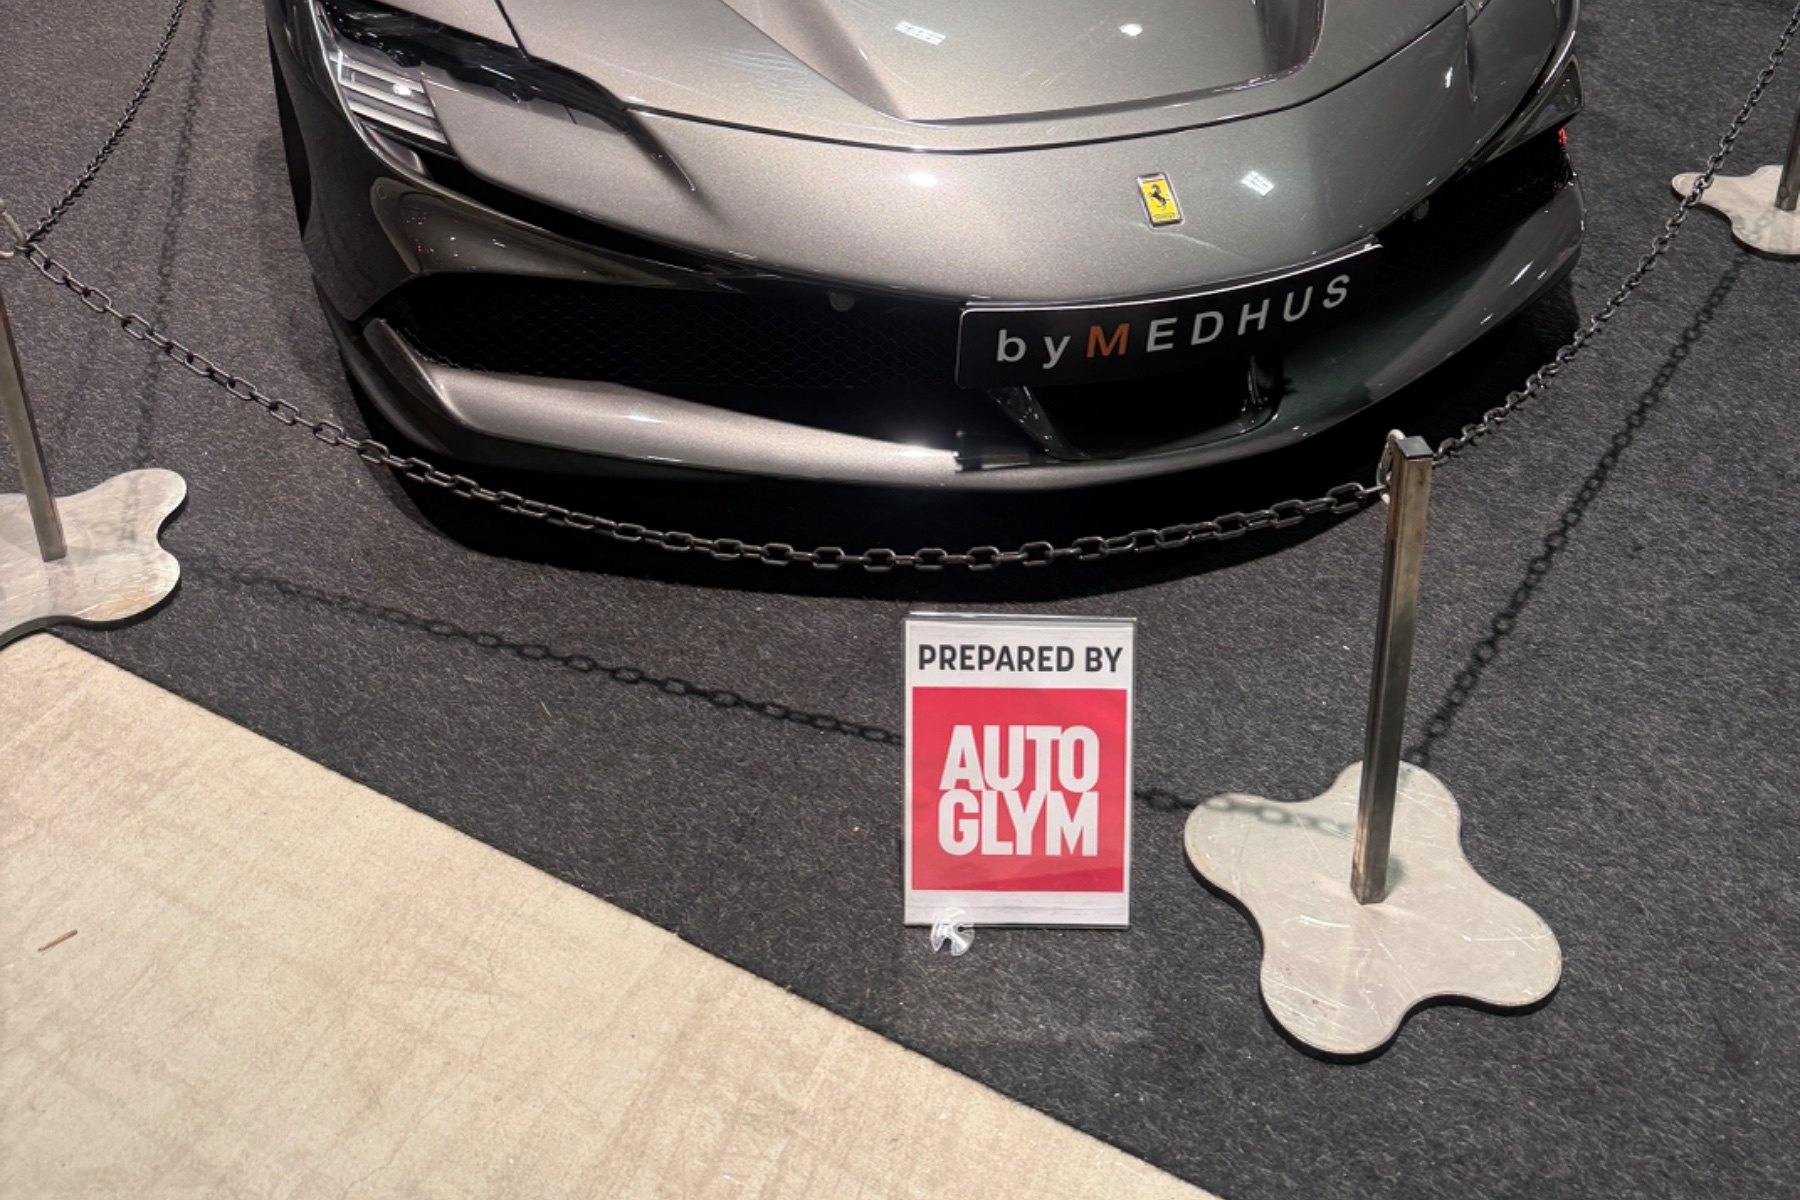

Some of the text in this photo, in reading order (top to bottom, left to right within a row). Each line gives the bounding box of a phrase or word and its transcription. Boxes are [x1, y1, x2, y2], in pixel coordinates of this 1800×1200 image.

[918, 644, 1123, 672] PREPARED BY
[939, 725, 1099, 793] AUTO
[938, 789, 1099, 856] GLYM
